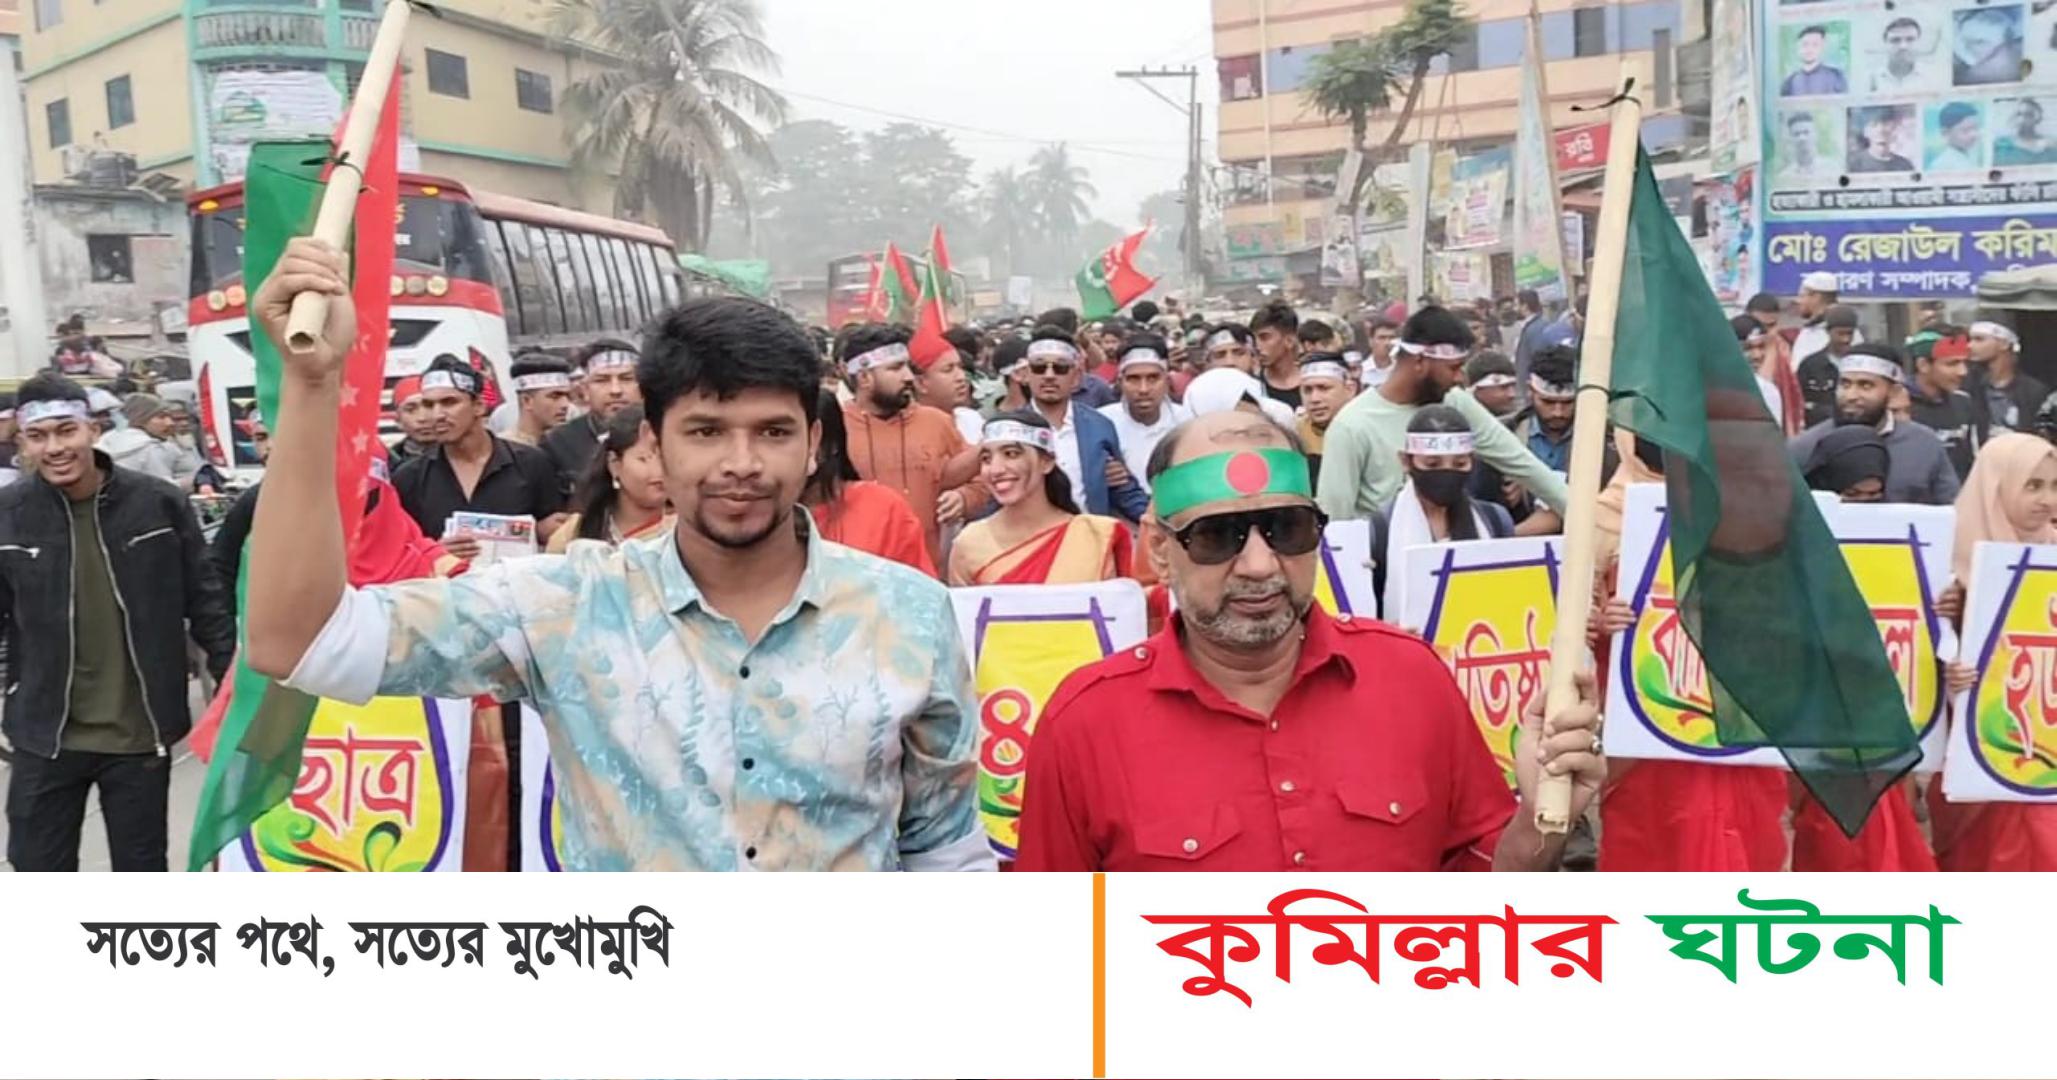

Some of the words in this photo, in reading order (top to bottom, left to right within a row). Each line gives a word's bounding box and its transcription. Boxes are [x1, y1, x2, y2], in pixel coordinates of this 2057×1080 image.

[1768, 230, 1827, 264] মোঃ
[1838, 222, 1963, 263] রেজাউল
[1880, 270, 1977, 294] সম্পাদক,
[291, 726, 425, 836] ছাত্র
